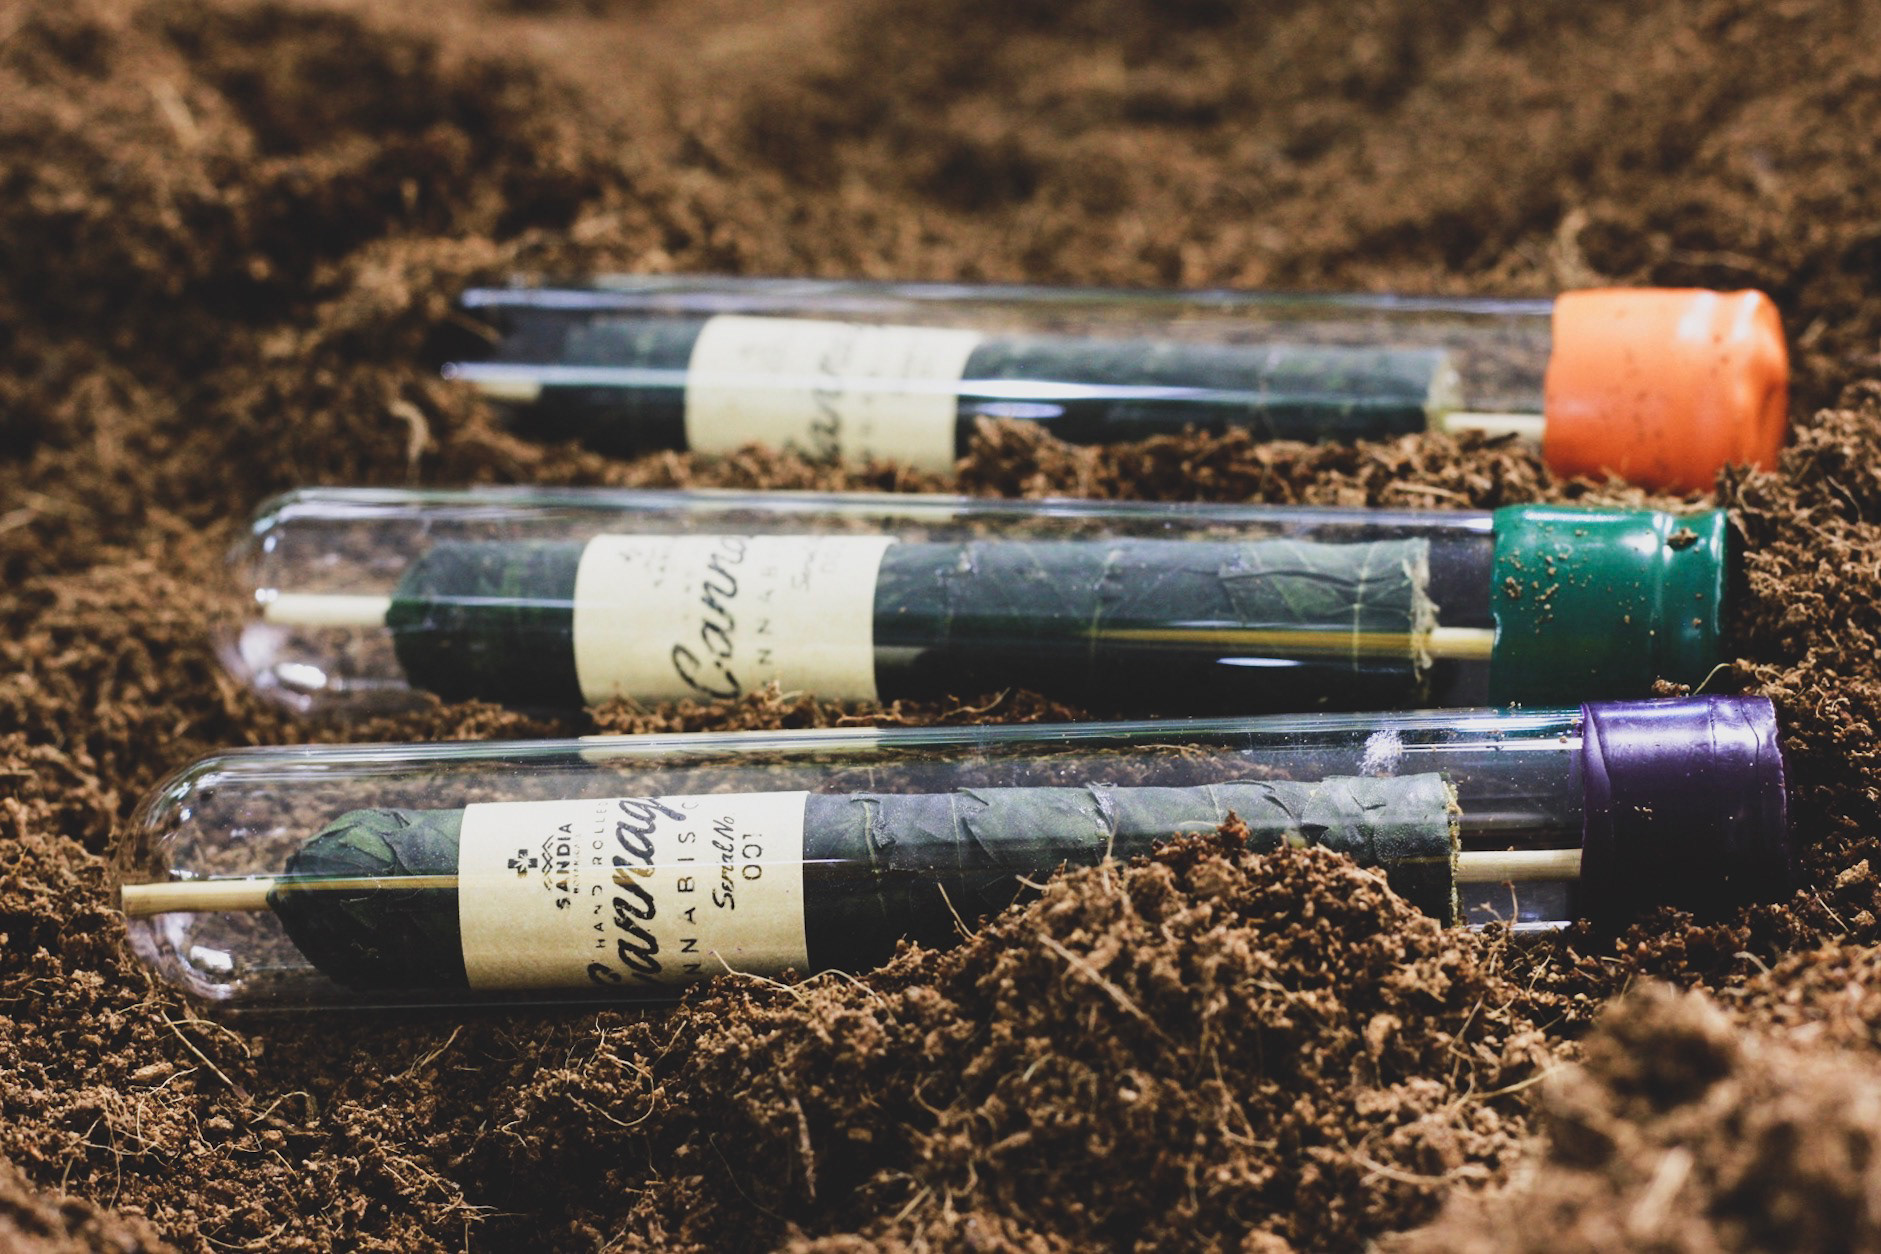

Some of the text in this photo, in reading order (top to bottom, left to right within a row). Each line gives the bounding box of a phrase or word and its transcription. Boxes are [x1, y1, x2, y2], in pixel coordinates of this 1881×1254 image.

[556, 823, 573, 910] SANDIA
[712, 839, 735, 911] Serial
[742, 833, 764, 881] 001
[591, 884, 606, 949] HAND
